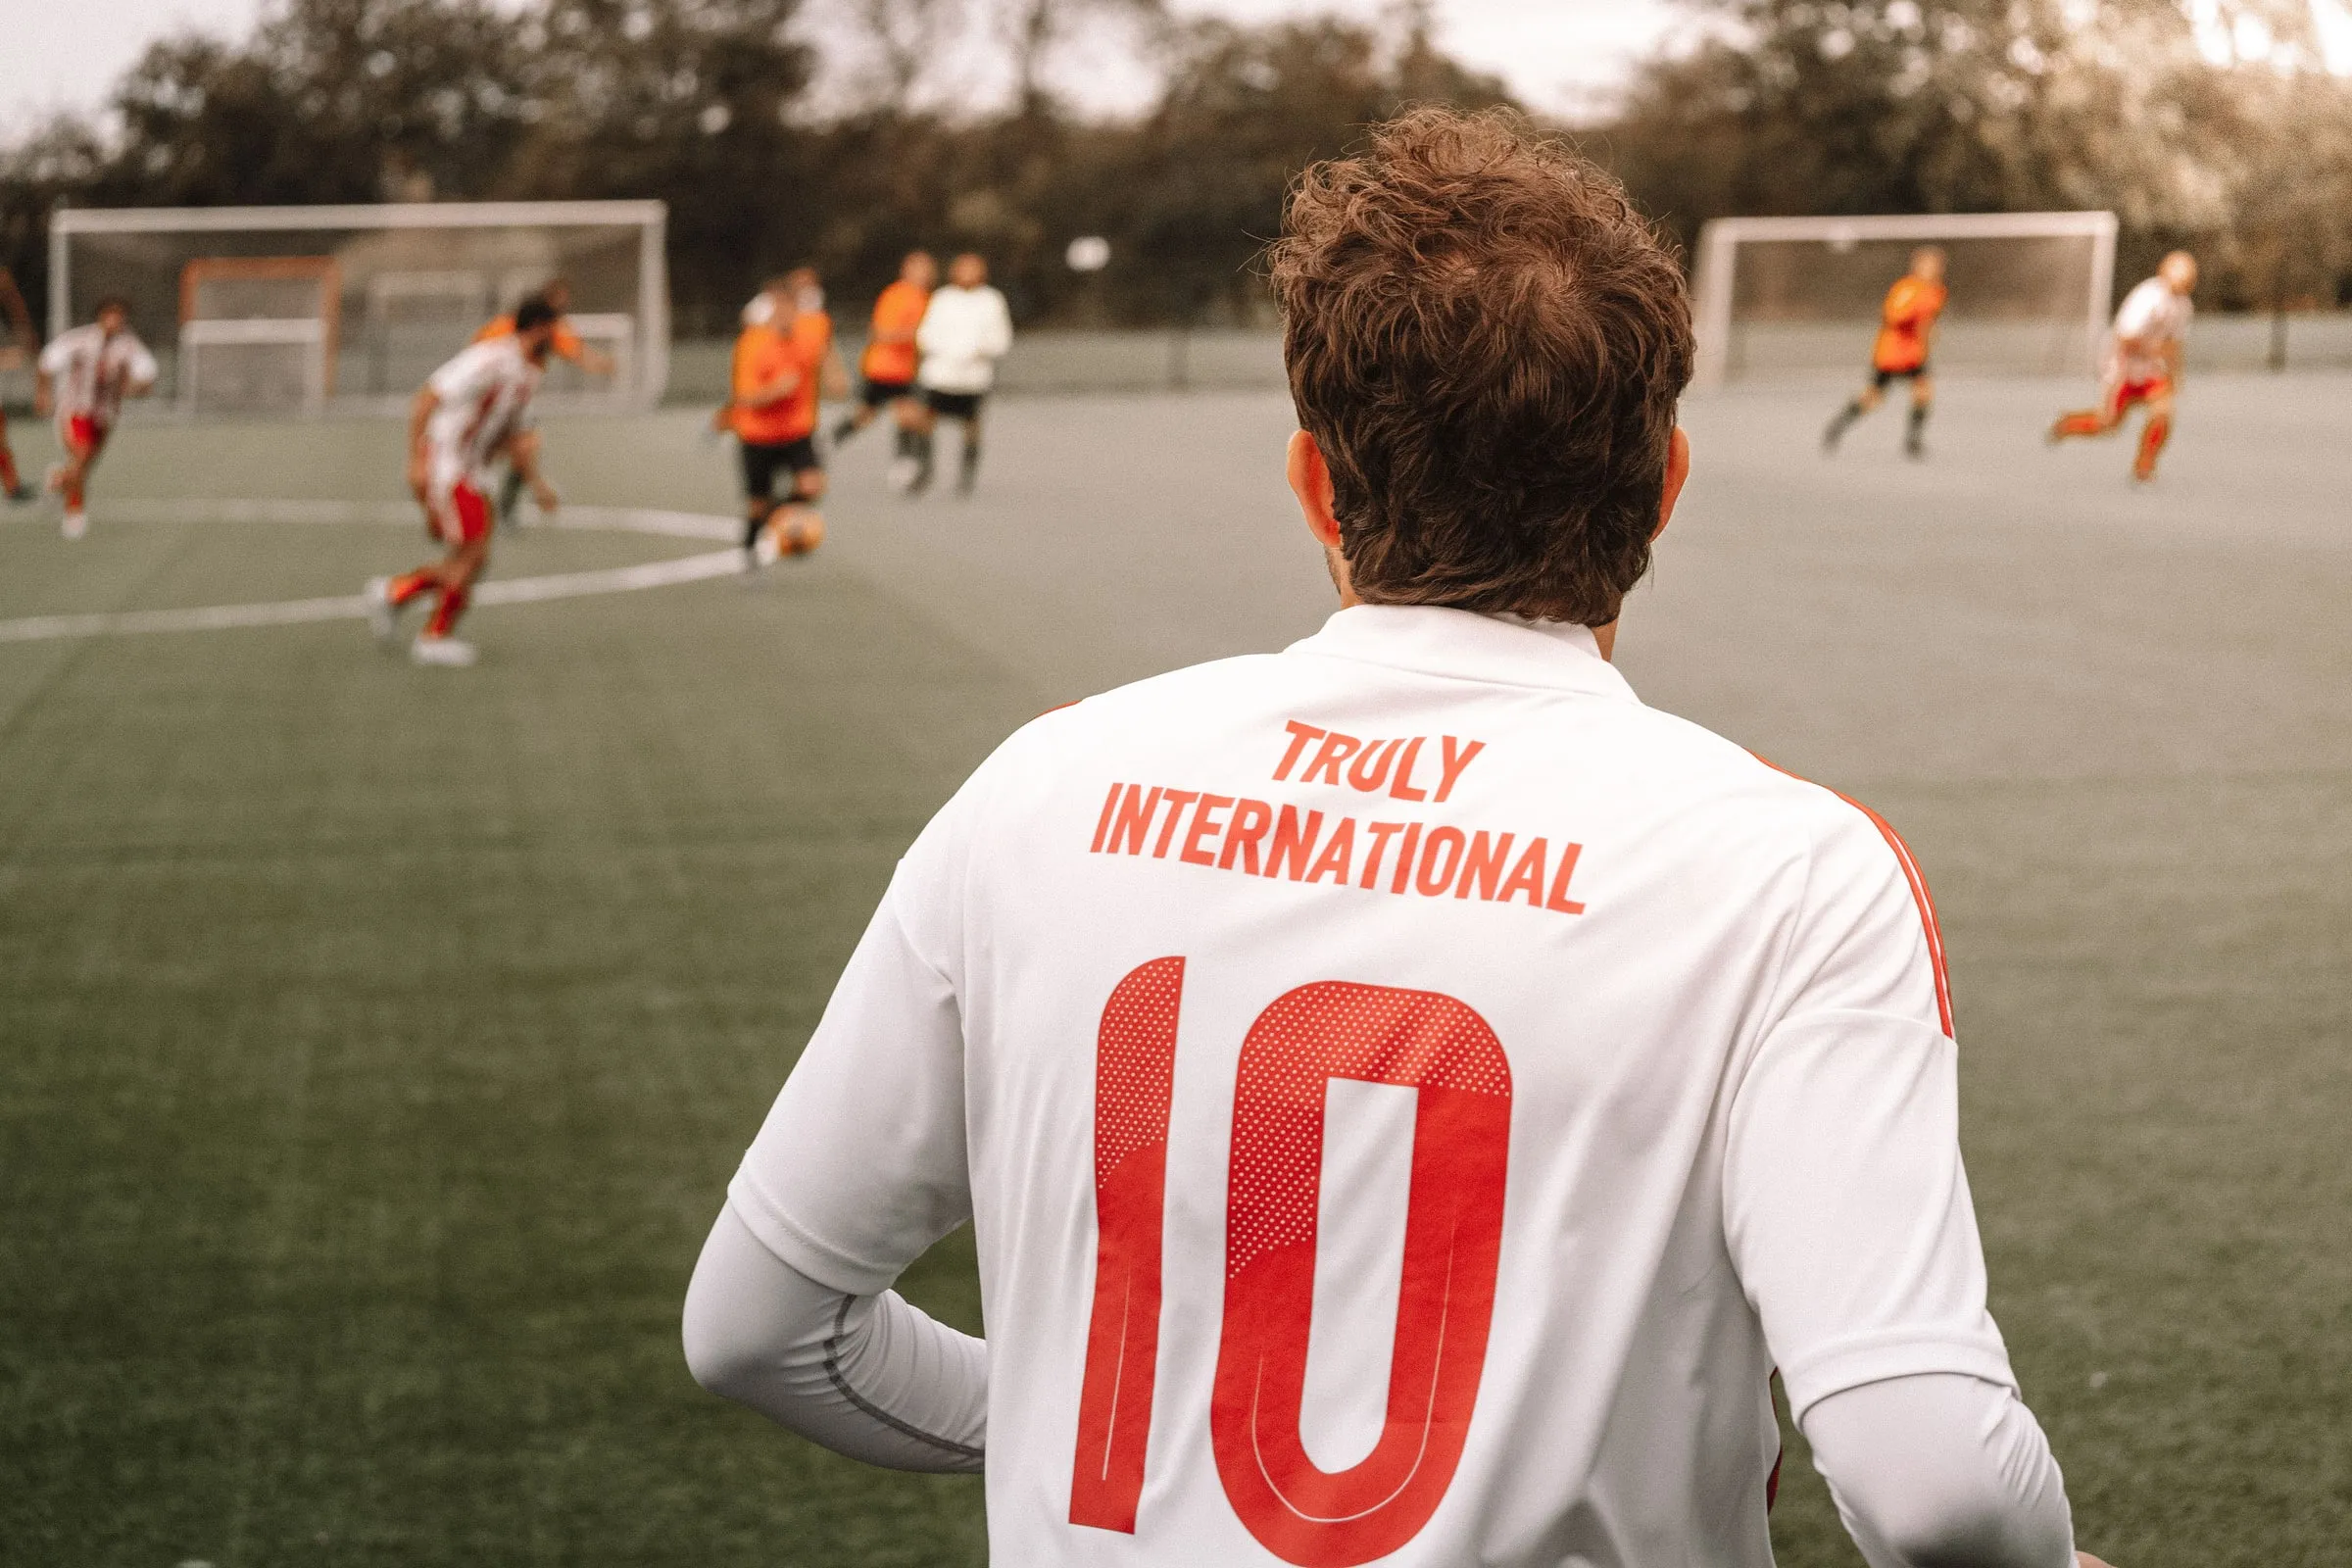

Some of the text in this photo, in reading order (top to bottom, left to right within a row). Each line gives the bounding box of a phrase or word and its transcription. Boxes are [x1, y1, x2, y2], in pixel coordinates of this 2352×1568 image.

[1272, 719, 1486, 804] TRULY
[1090, 782, 1586, 915] INTERNATIONAL
[1068, 956, 1514, 1568] 10
